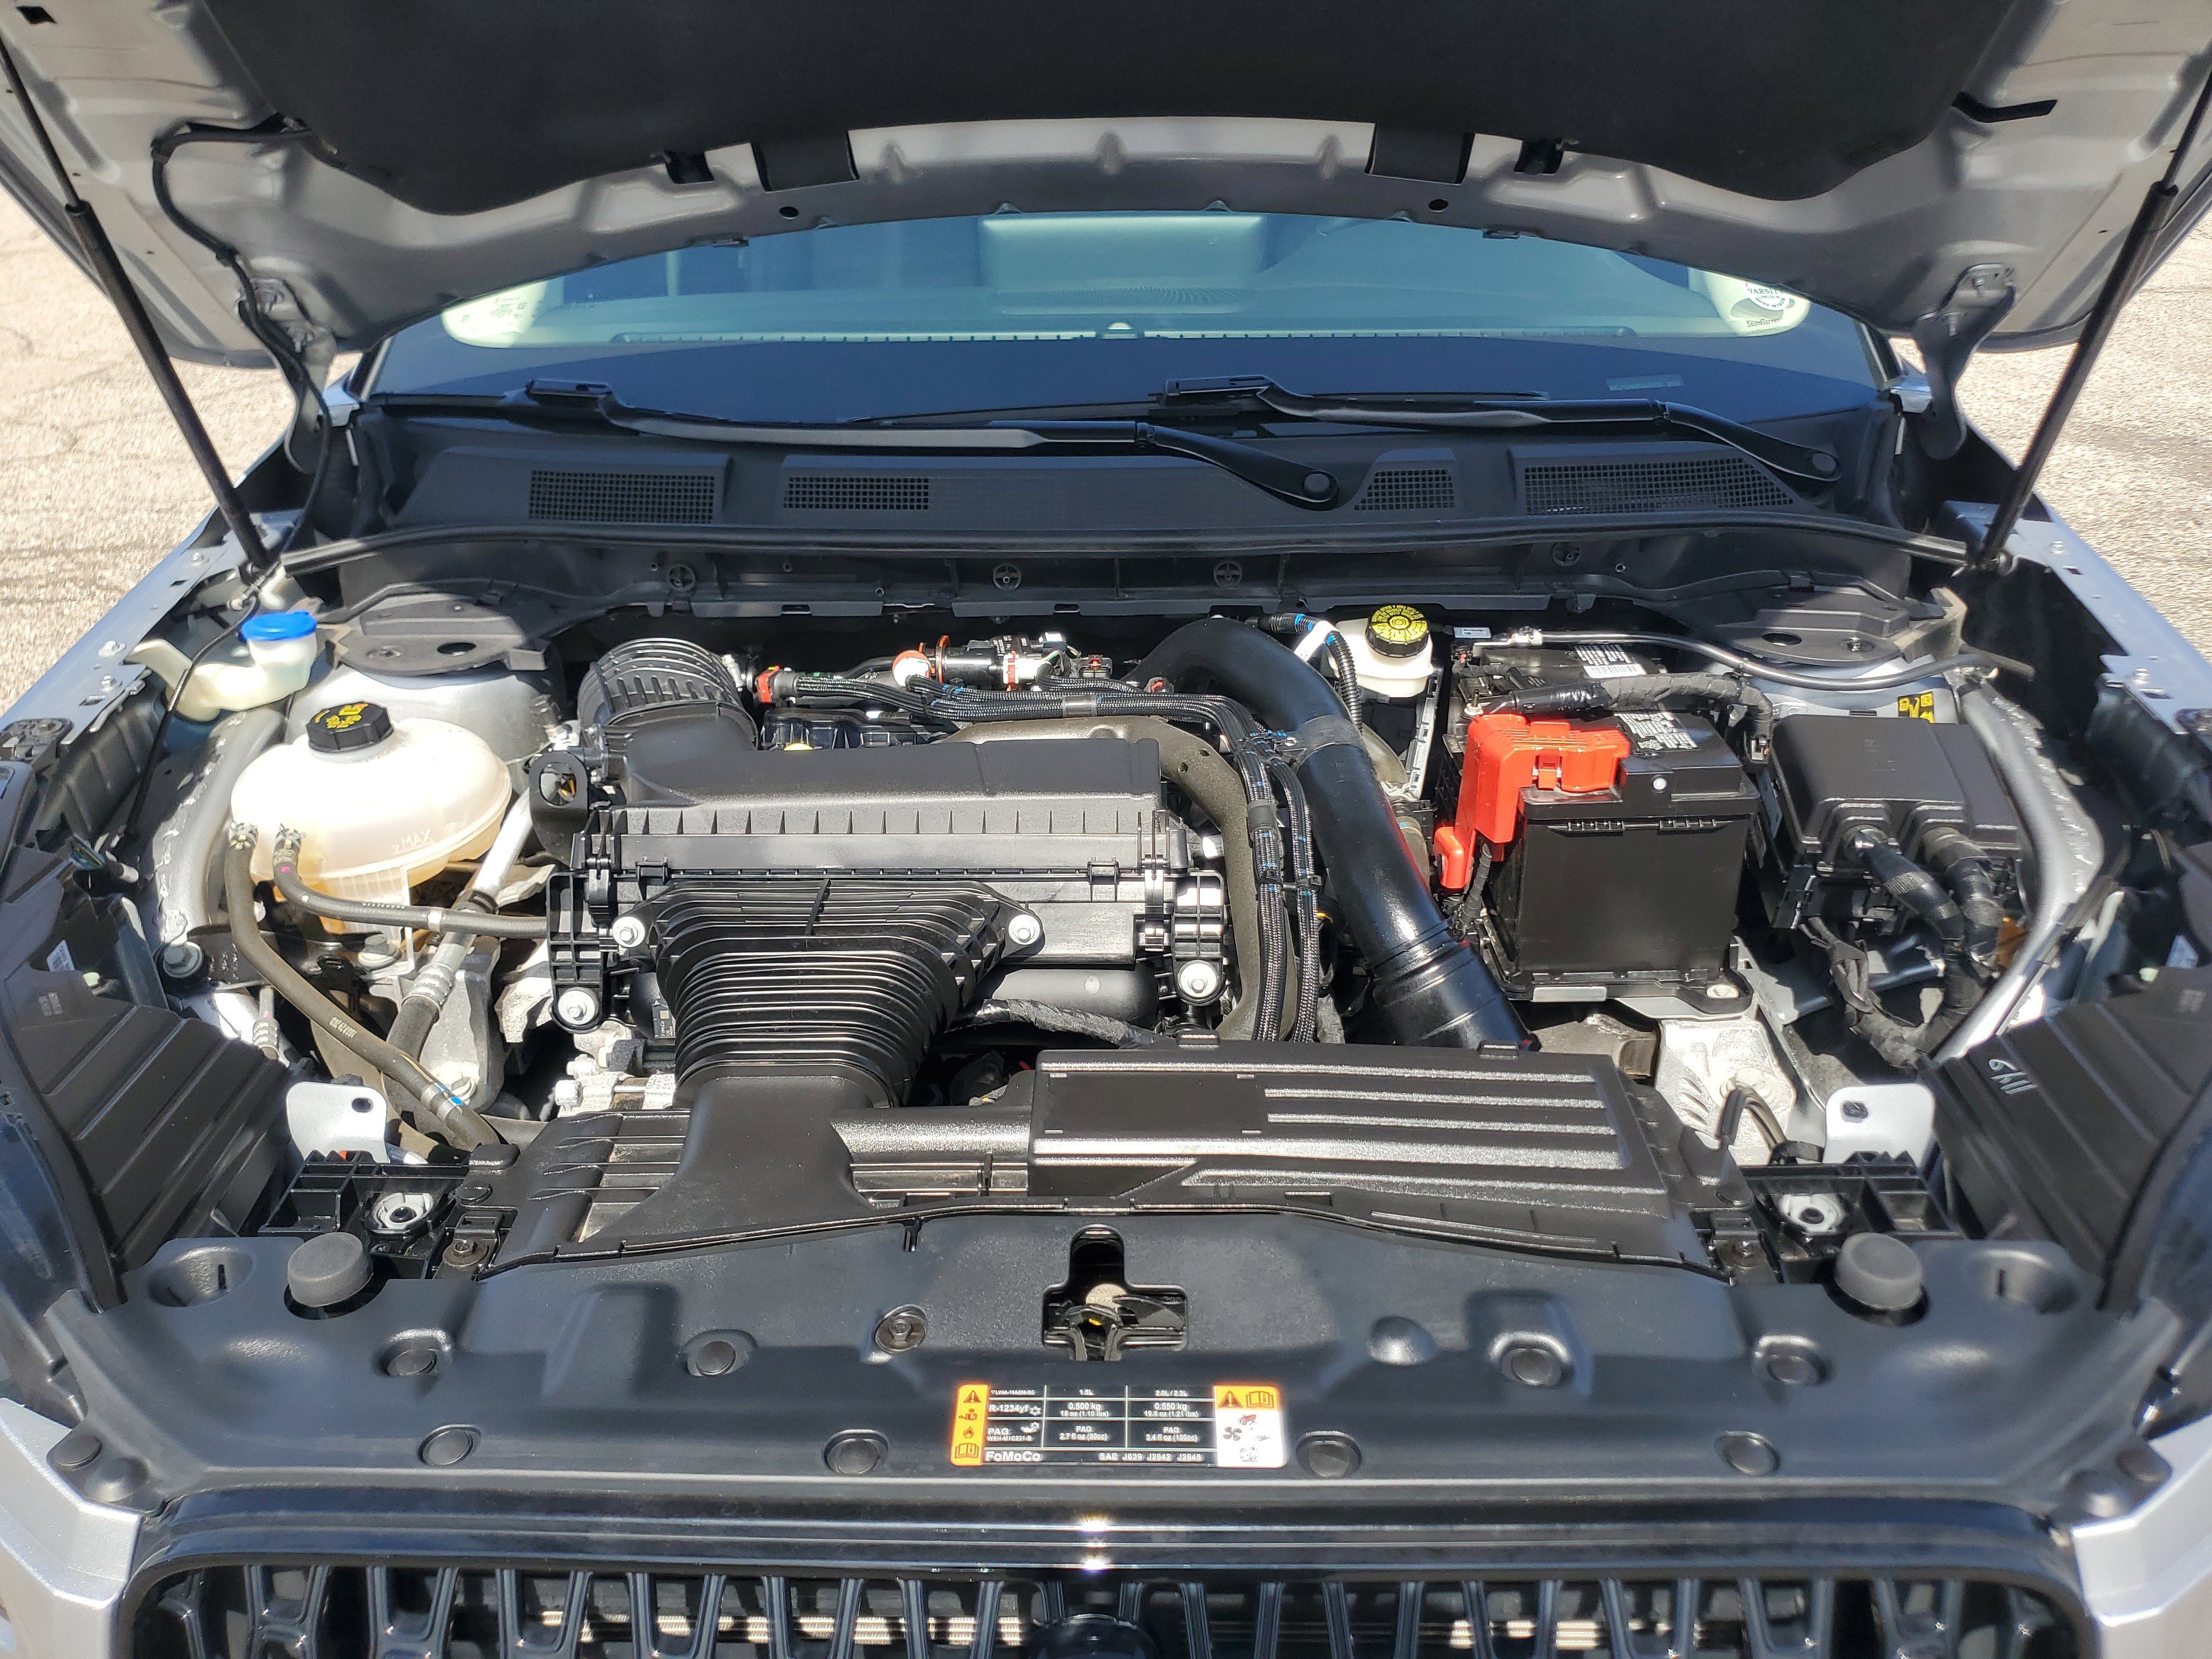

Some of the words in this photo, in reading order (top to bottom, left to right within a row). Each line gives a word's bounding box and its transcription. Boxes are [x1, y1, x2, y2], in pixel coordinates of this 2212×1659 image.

[989, 1404, 1029, 1414] R-1234yf
[1091, 1402, 1101, 1411] kg
[1177, 1402, 1187, 1412] kg
[1173, 1434, 1198, 1442] (100cc)
[986, 1451, 1041, 1461] FoMoCo
